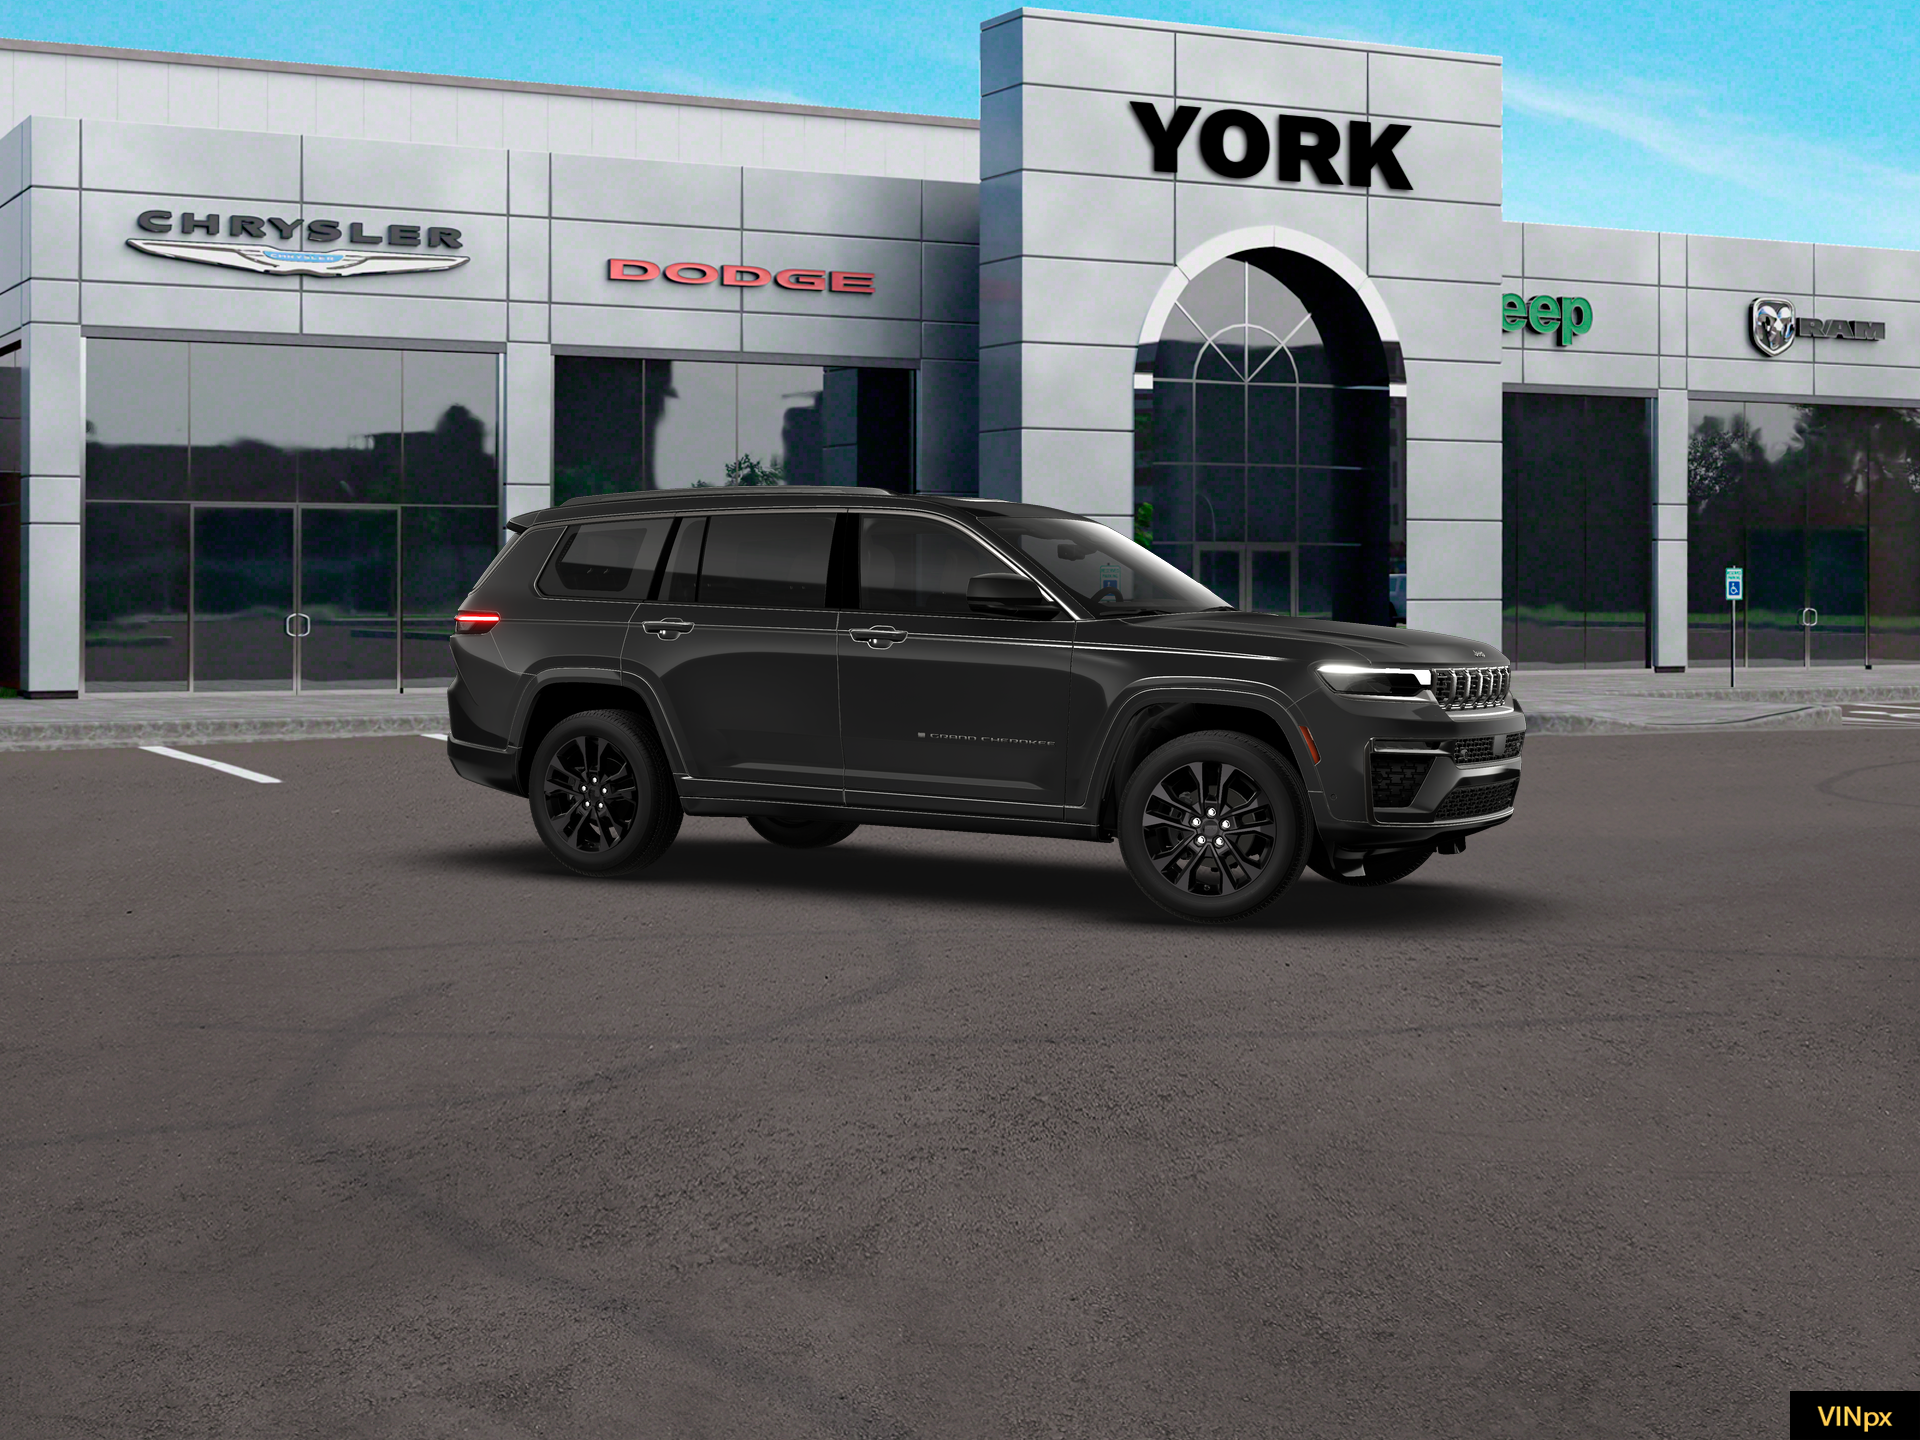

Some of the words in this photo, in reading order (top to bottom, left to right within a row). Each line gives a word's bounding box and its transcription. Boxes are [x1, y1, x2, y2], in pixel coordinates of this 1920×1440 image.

[1129, 101, 1414, 190] YORK
[137, 209, 464, 249] CHRYSLER
[270, 253, 335, 261] CHRYSLER
[607, 258, 876, 294] DODGE
[1502, 293, 1593, 347] eep
[1796, 317, 1886, 341] RAM
[929, 733, 977, 741] GRAND
[981, 736, 1056, 746] CHEROKEE
